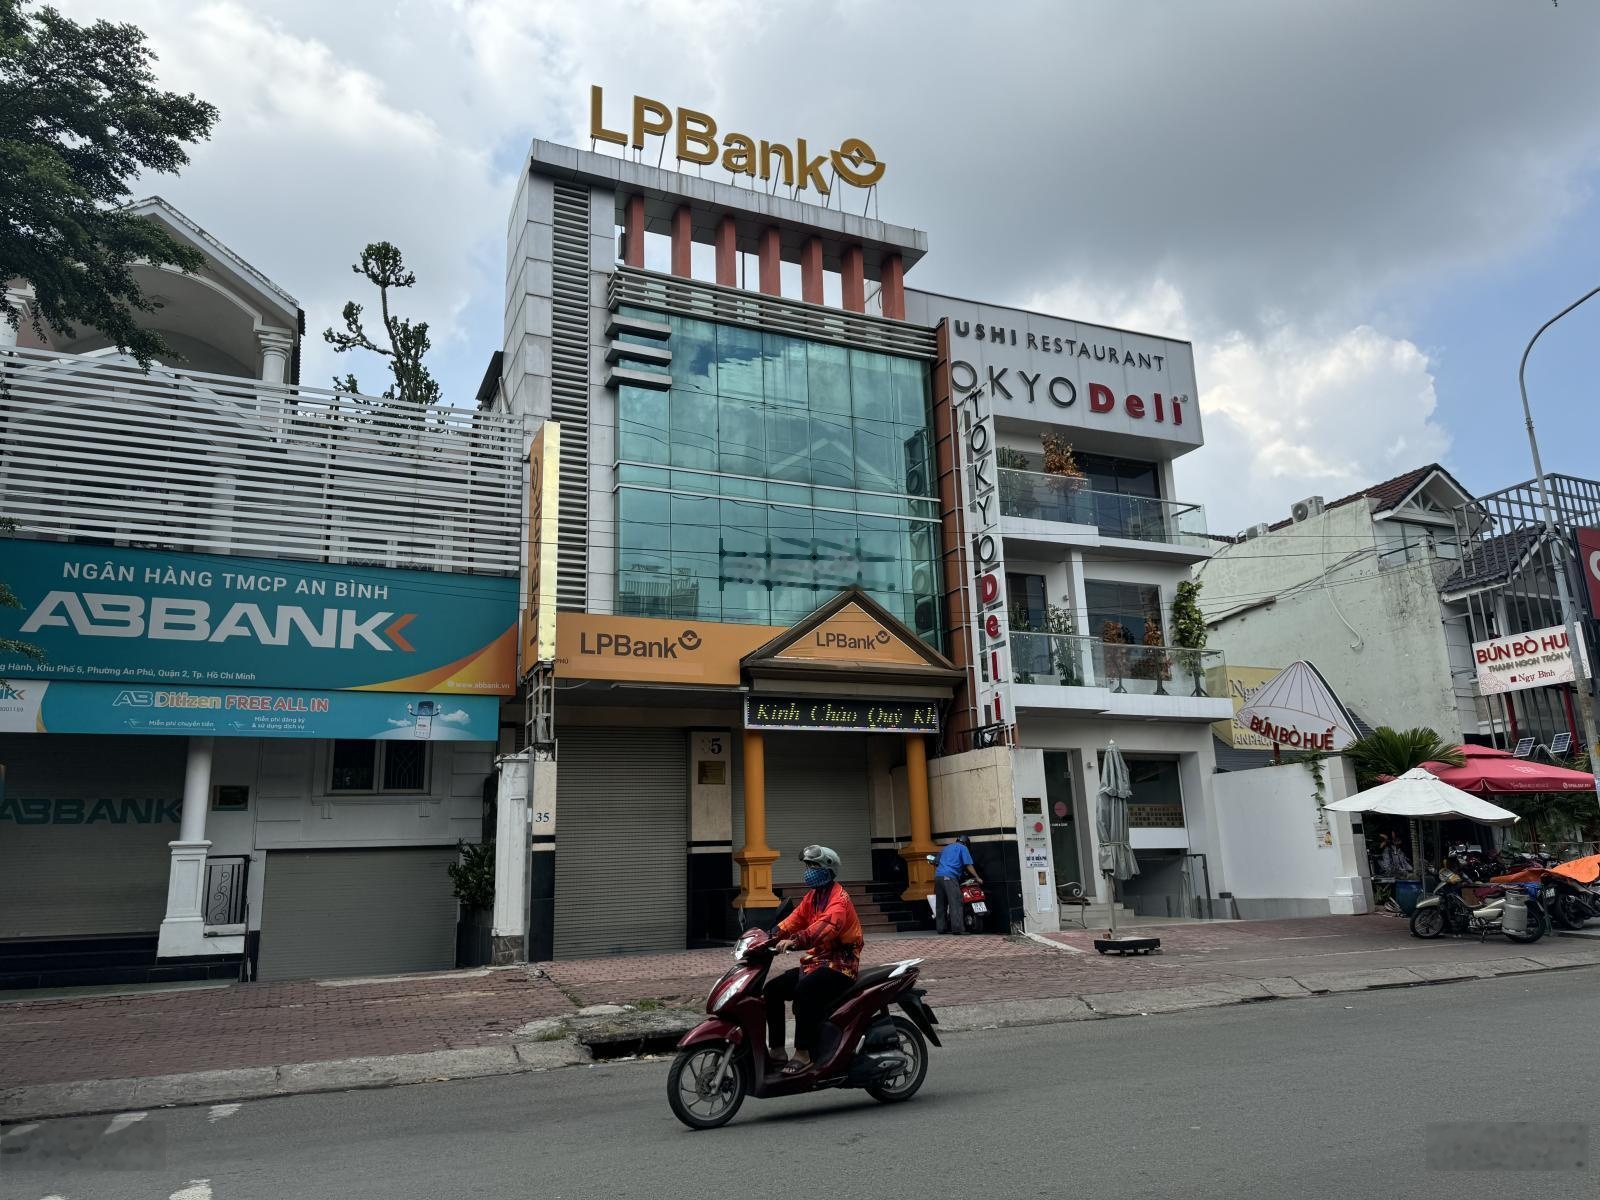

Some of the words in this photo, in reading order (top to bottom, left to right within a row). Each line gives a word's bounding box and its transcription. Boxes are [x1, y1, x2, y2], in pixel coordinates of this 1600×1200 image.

[590, 85, 829, 195] LPBank
[940, 317, 1017, 346] USHI
[1027, 332, 1165, 372] RESTAURANT
[952, 360, 1077, 408] OKYO
[1088, 382, 1183, 426] Deli
[970, 389, 995, 564] TOKYO
[63, 561, 135, 582] NGÂN
[144, 565, 213, 588] HÀNG
[222, 573, 287, 593] TMCP
[295, 579, 326, 596] AN
[335, 578, 389, 600] BÌNH
[19, 590, 395, 651] ABBANK
[580, 631, 678, 659] LPBank
[816, 631, 876, 650] LPBank
[981, 573, 1001, 721] Deli
[1476, 643, 1511, 664] BÚN
[1512, 636, 1539, 657] BÒ
[1541, 632, 1569, 652] HU
[88, 666, 121, 676] Phường
[158, 669, 180, 679] Quận
[206, 670, 219, 678] Hồ
[220, 672, 234, 680] Chí
[235, 672, 256, 680] Minh
[1488, 662, 1515, 673] THANH
[455, 681, 510, 690] www.abbank.vn
[225, 695, 273, 711] FREE
[273, 697, 308, 712] ALL
[310, 697, 330, 713] IN
[1250, 715, 1280, 741] BÚN
[1280, 725, 1301, 747] BÒ
[1303, 725, 1337, 750] HUẾ
[535, 812, 550, 823] 35
